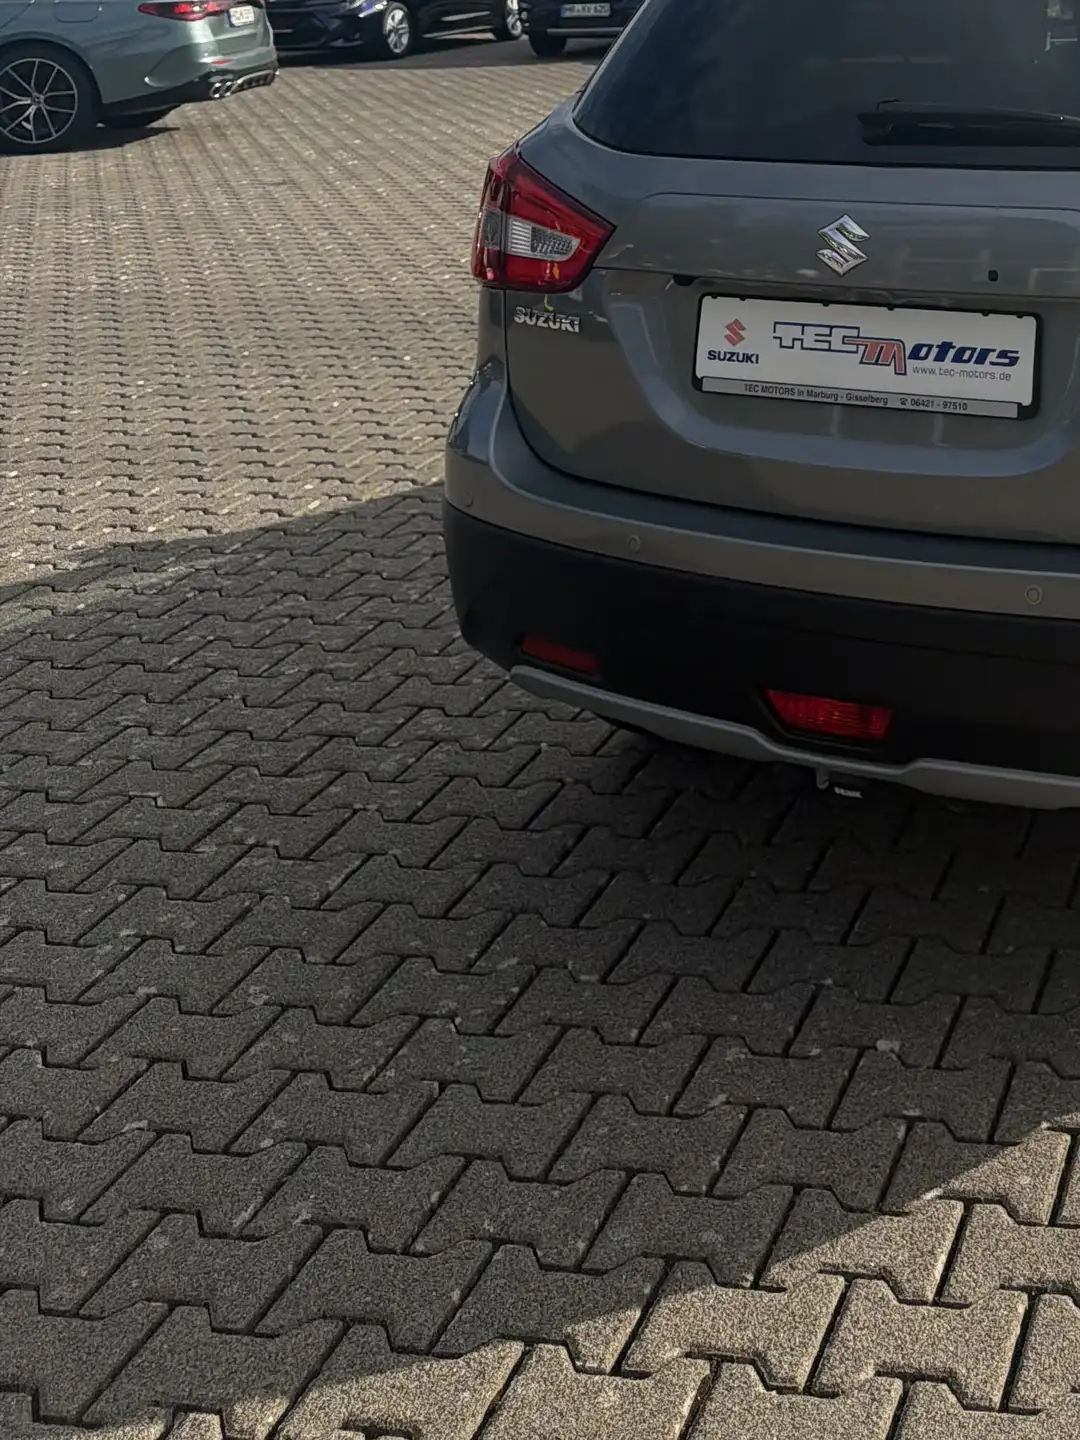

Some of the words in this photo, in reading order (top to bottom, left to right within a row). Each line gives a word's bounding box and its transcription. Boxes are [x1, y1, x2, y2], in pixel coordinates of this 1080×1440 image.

[514, 306, 580, 333] SUZUKI
[707, 349, 760, 365] SUZUKI
[912, 365, 1012, 381] www.tec-motors.de
[744, 384, 760, 393] TEC
[761, 385, 796, 397] MOTORS
[797, 389, 804, 397] in
[806, 389, 839, 402] Marburg
[845, 392, 889, 406] Gisselberg
[910, 398, 935, 409] 06421
[942, 401, 968, 411] 97510
